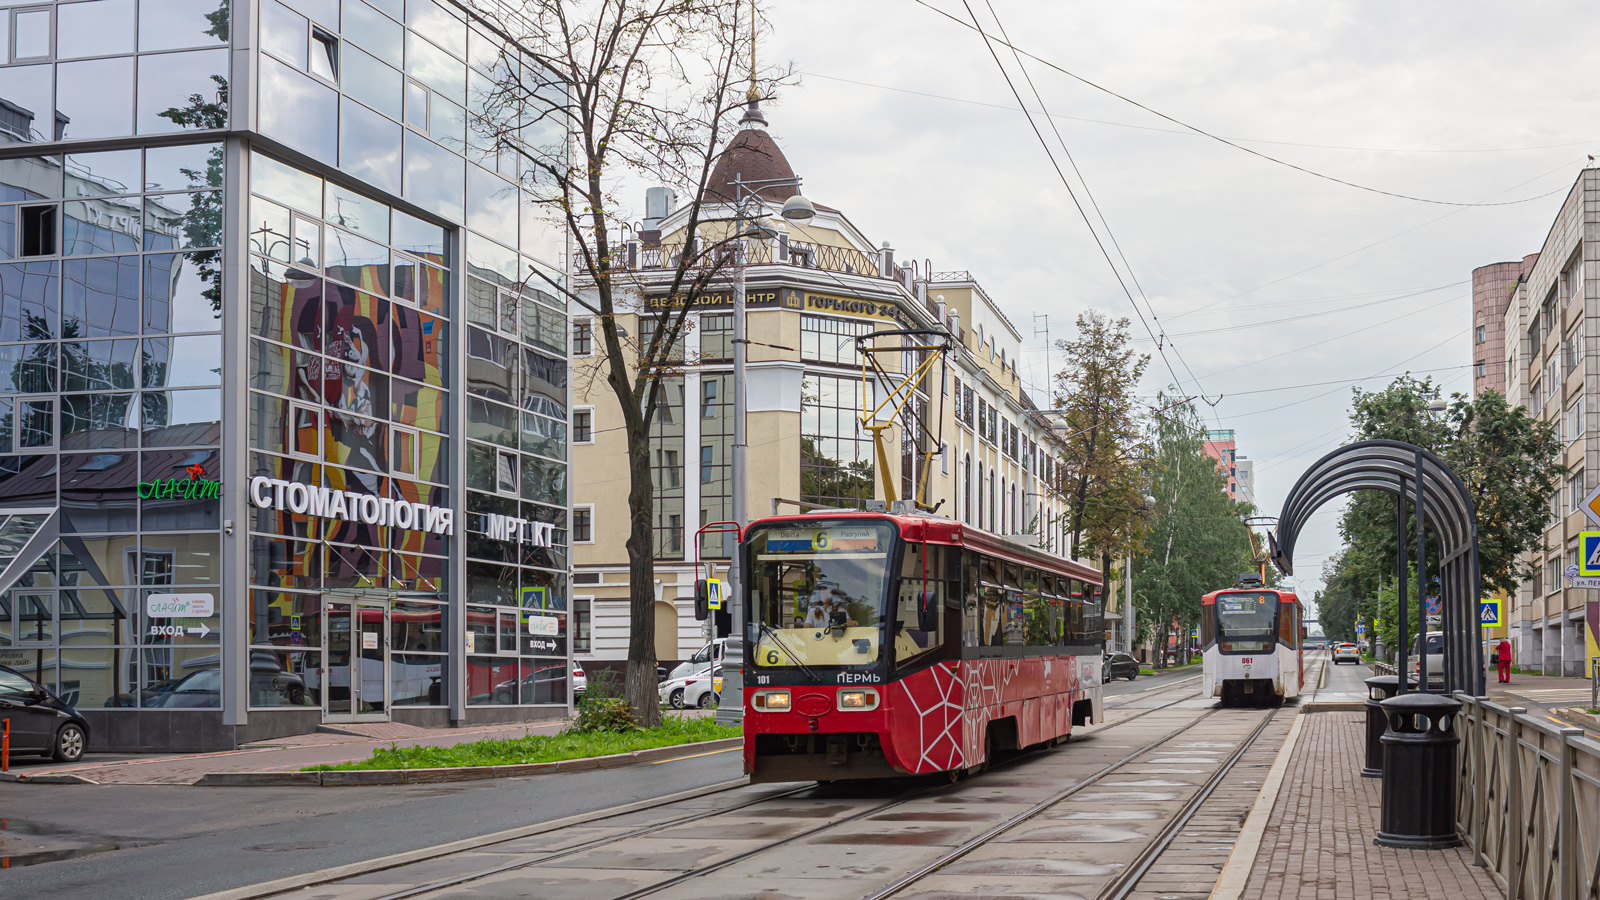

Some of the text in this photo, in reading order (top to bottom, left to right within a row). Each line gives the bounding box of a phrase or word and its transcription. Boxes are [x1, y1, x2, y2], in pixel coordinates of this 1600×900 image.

[726, 293, 776, 304] ЦНТР
[808, 295, 877, 314] ГОРЬКОГО
[250, 476, 454, 536] СТОМАТОЛОГИЯ
[487, 513, 555, 548] МРТ КТ
[816, 531, 828, 549] 6
[150, 625, 184, 637] ВХОД
[529, 640, 546, 650] ВХОД
[766, 649, 780, 665] 6
[757, 675, 770, 684] 101
[837, 673, 881, 683] ПЕРМЬ
